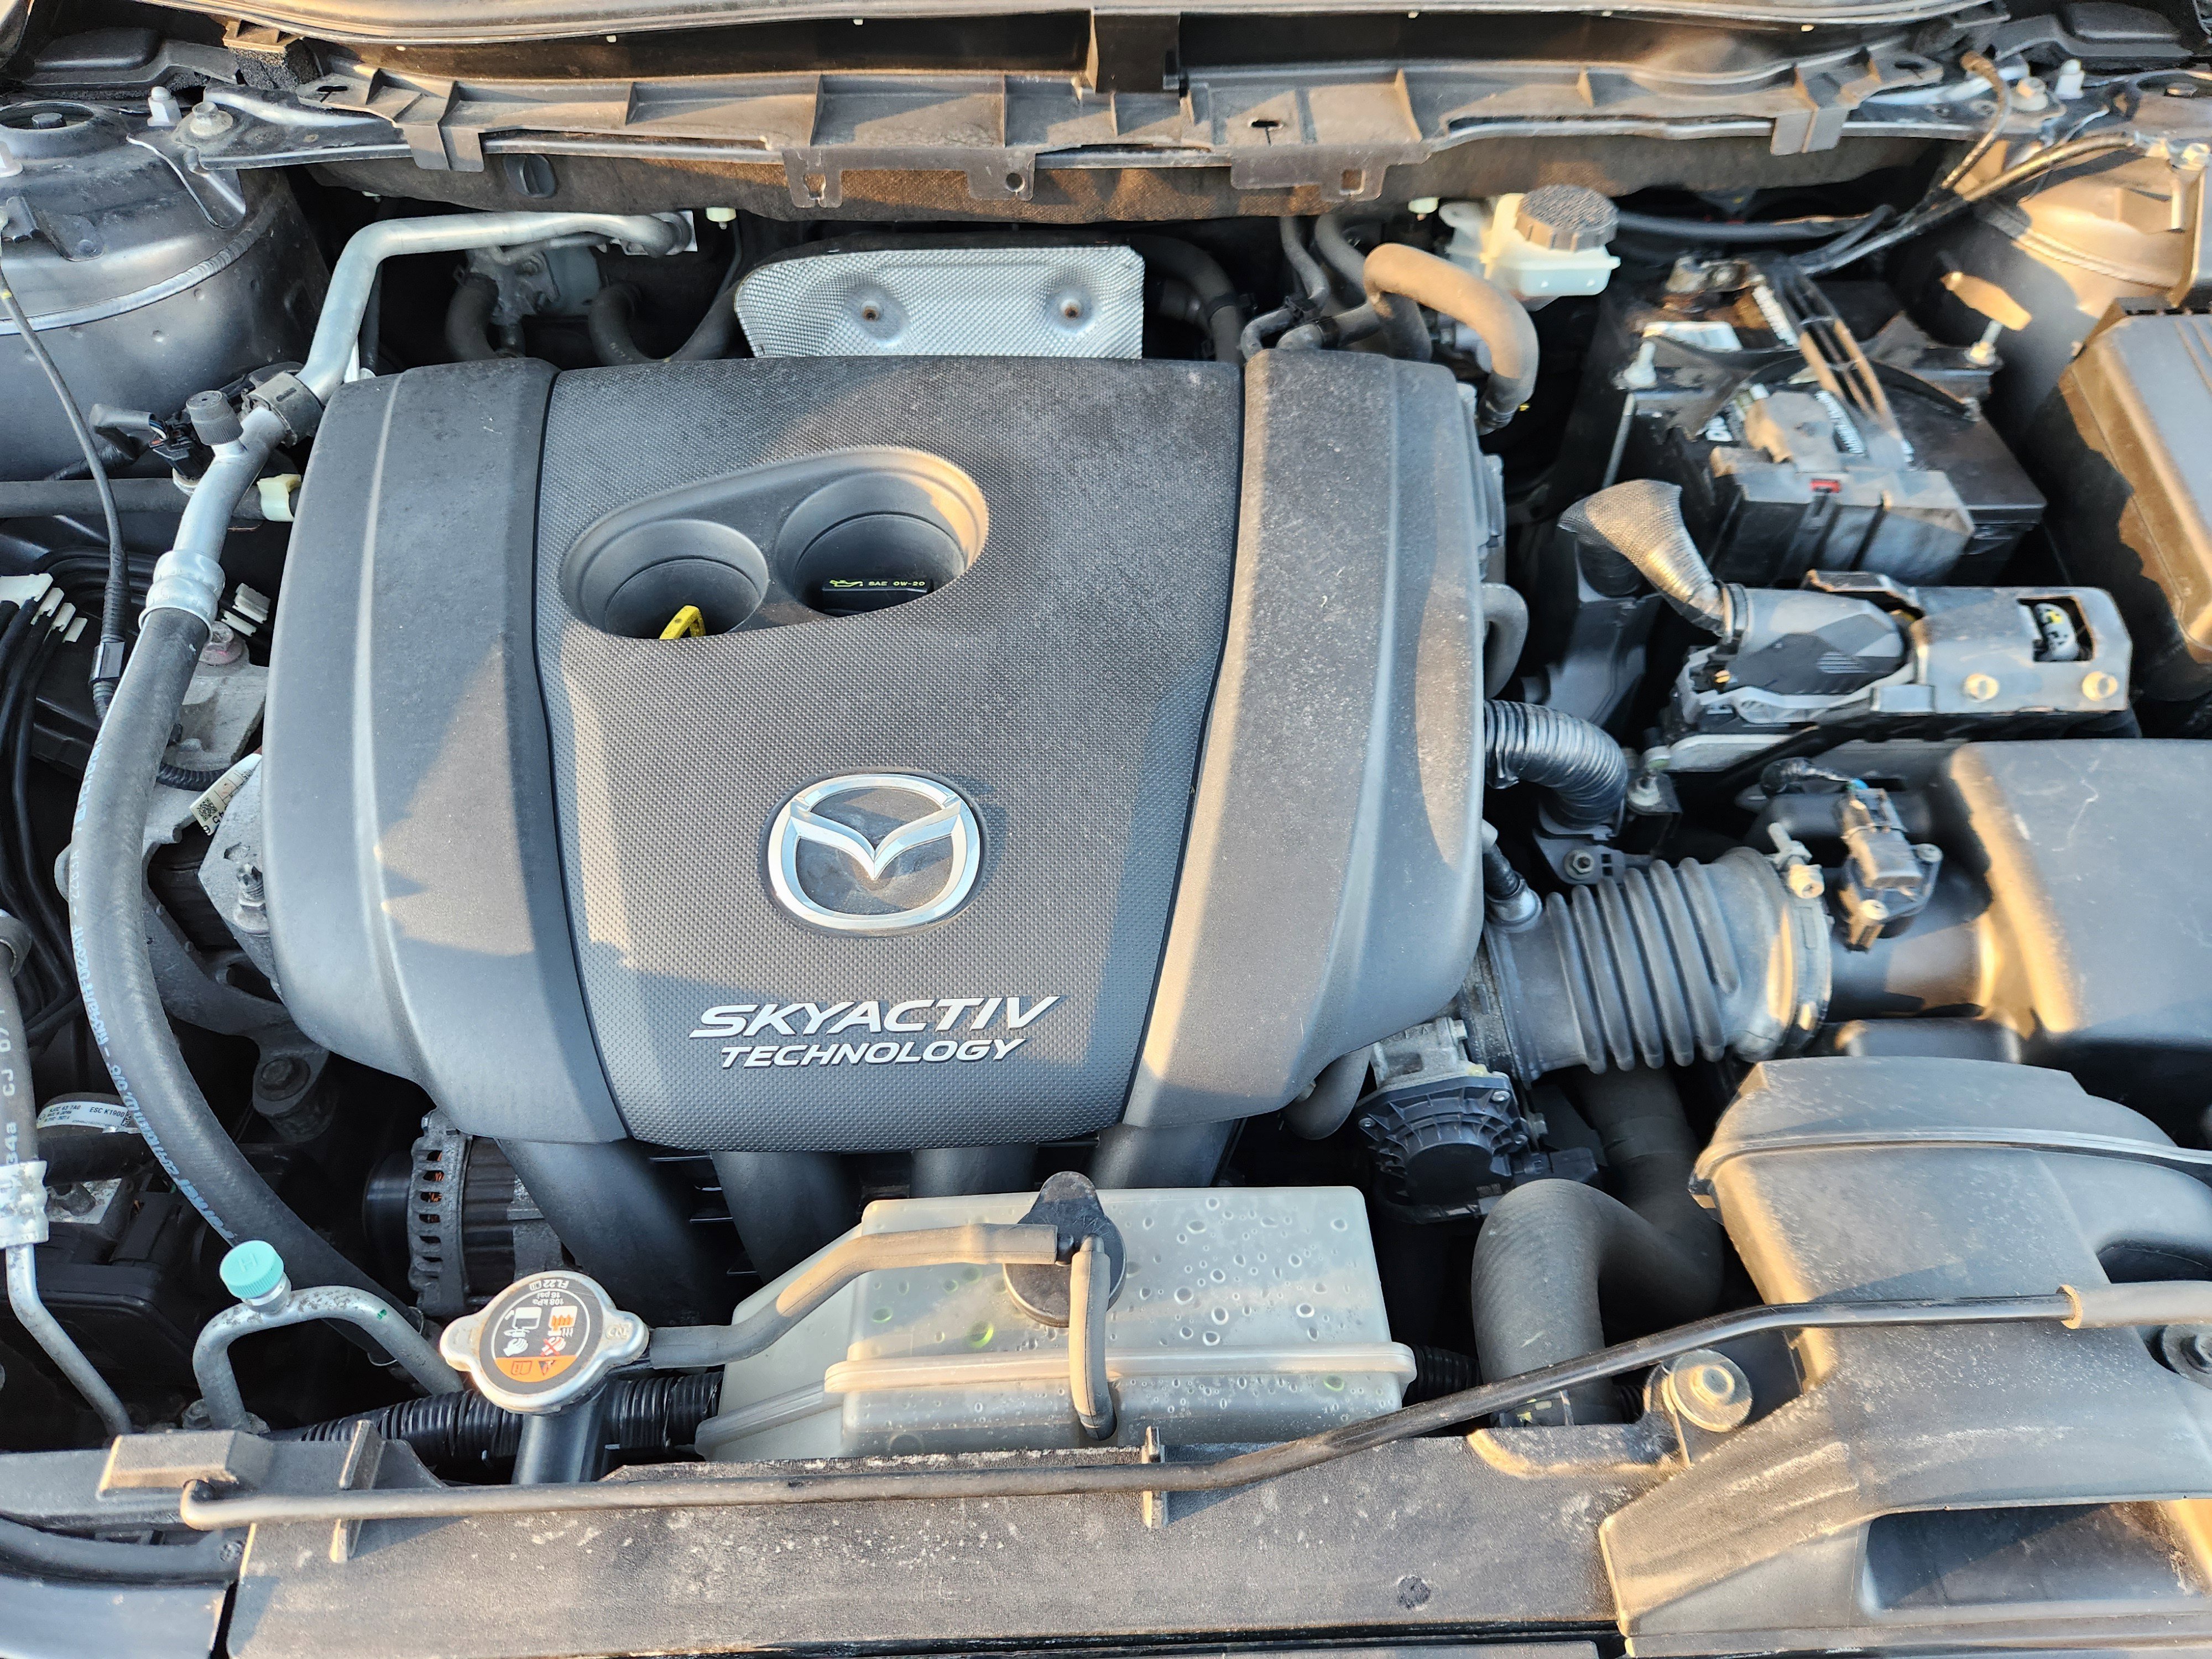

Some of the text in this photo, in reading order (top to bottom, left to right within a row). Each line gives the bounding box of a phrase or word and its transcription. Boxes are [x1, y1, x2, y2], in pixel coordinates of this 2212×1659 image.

[689, 995, 1060, 1039] SKYACTIV
[721, 1038, 1027, 1068] TECHNOLOGY
[1, 1068, 15, 1097] CJ
[103, 1108, 125, 1118] K1900
[238, 1253, 258, 1273] H
[542, 1279, 569, 1289] FL22
[536, 1291, 550, 1300] psi
